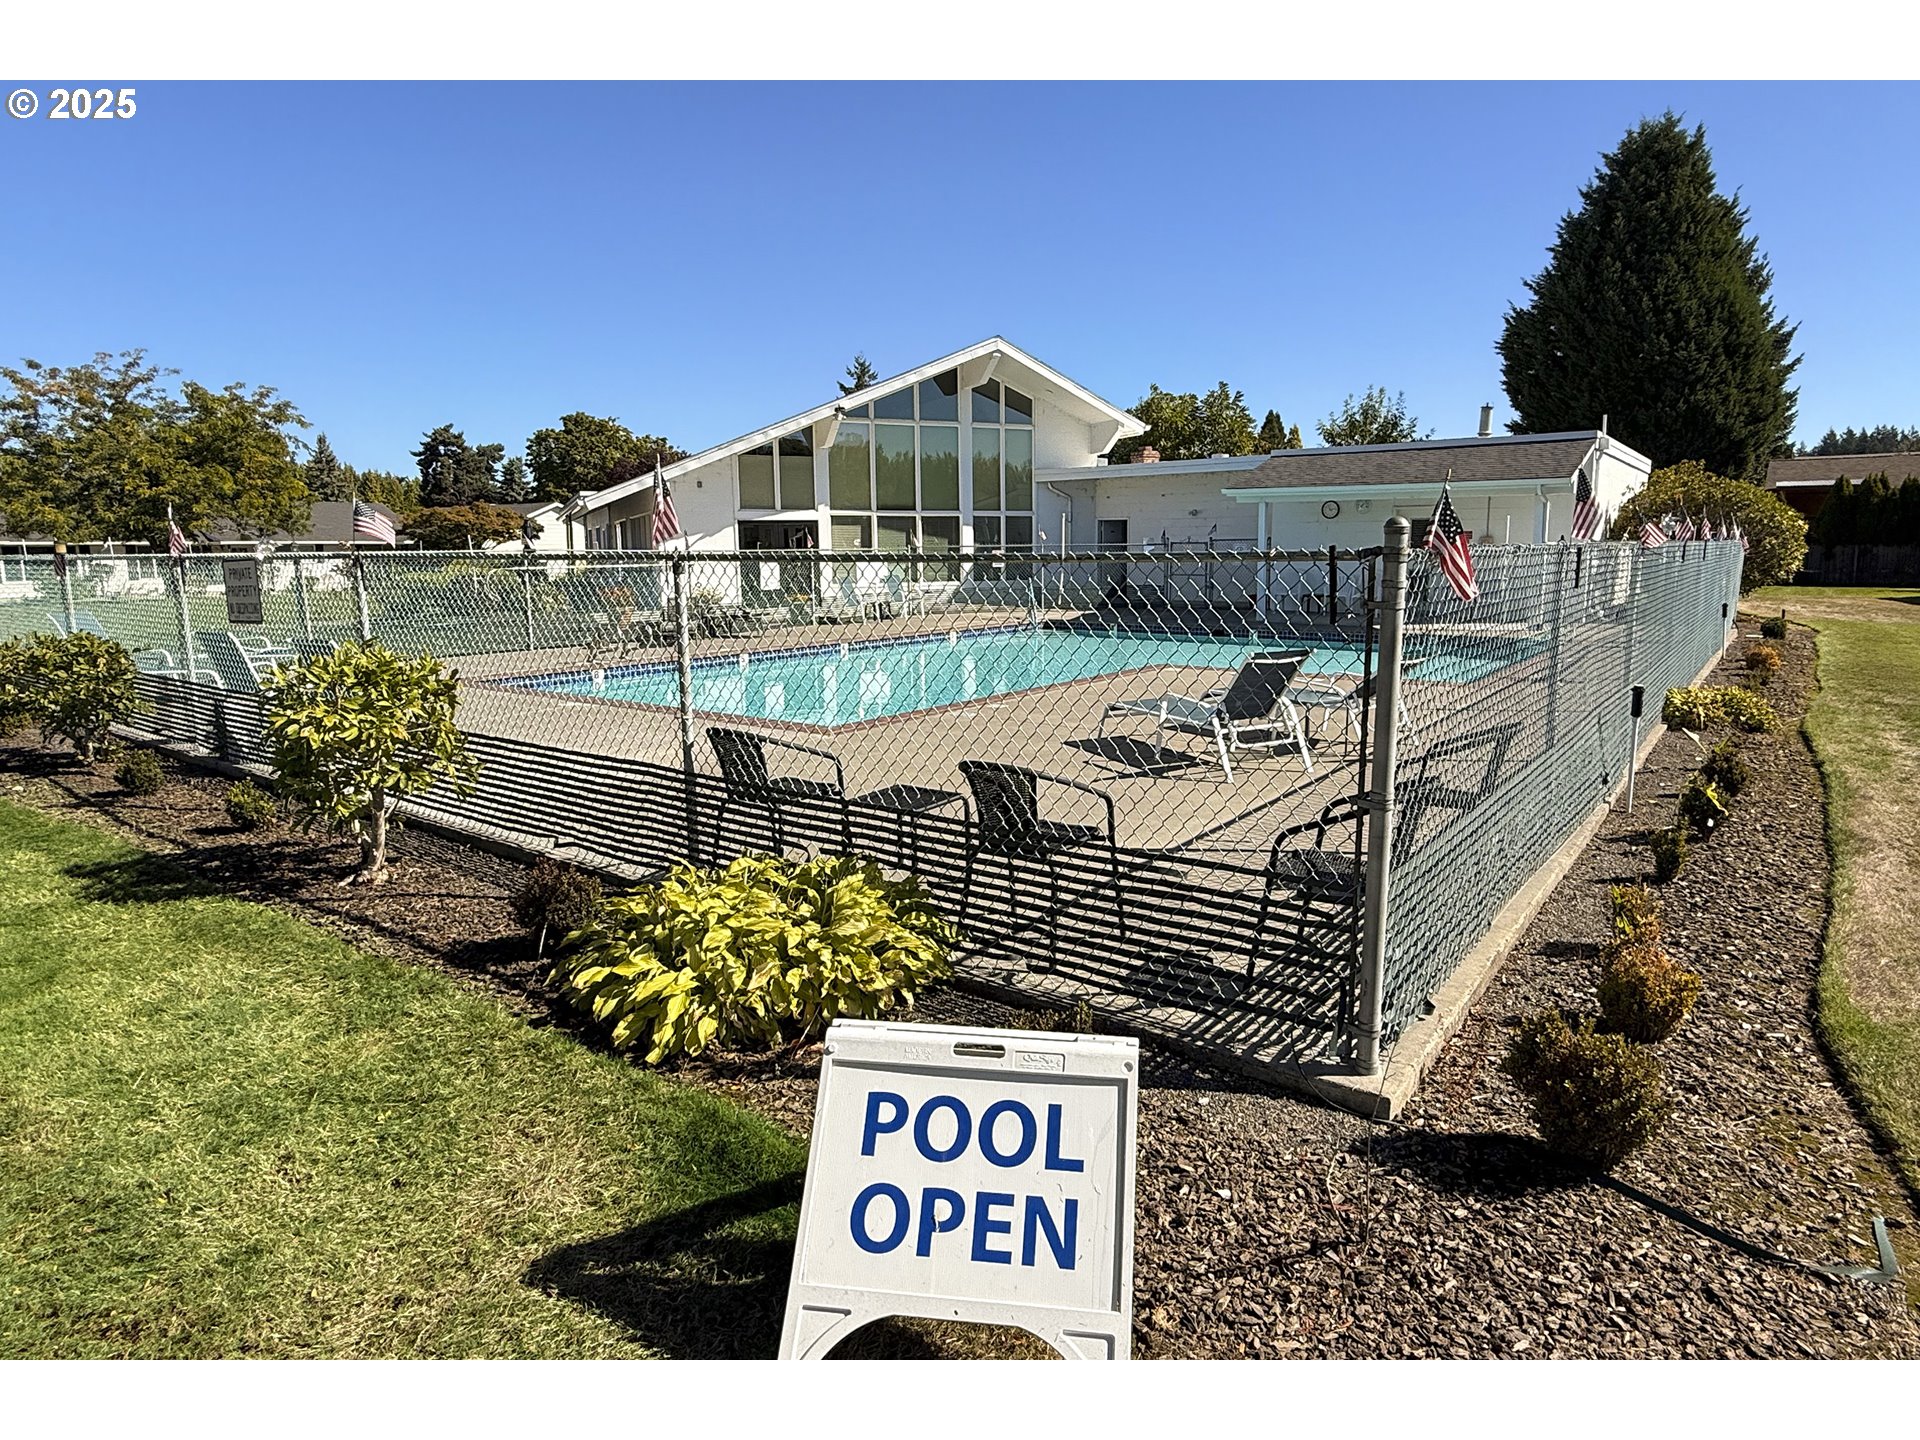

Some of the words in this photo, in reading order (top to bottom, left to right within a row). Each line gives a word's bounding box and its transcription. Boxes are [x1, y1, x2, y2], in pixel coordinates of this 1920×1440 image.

[228, 567, 252, 580] PRIVATE
[861, 1091, 1084, 1173] POOL
[850, 1182, 1079, 1271] OPEN
